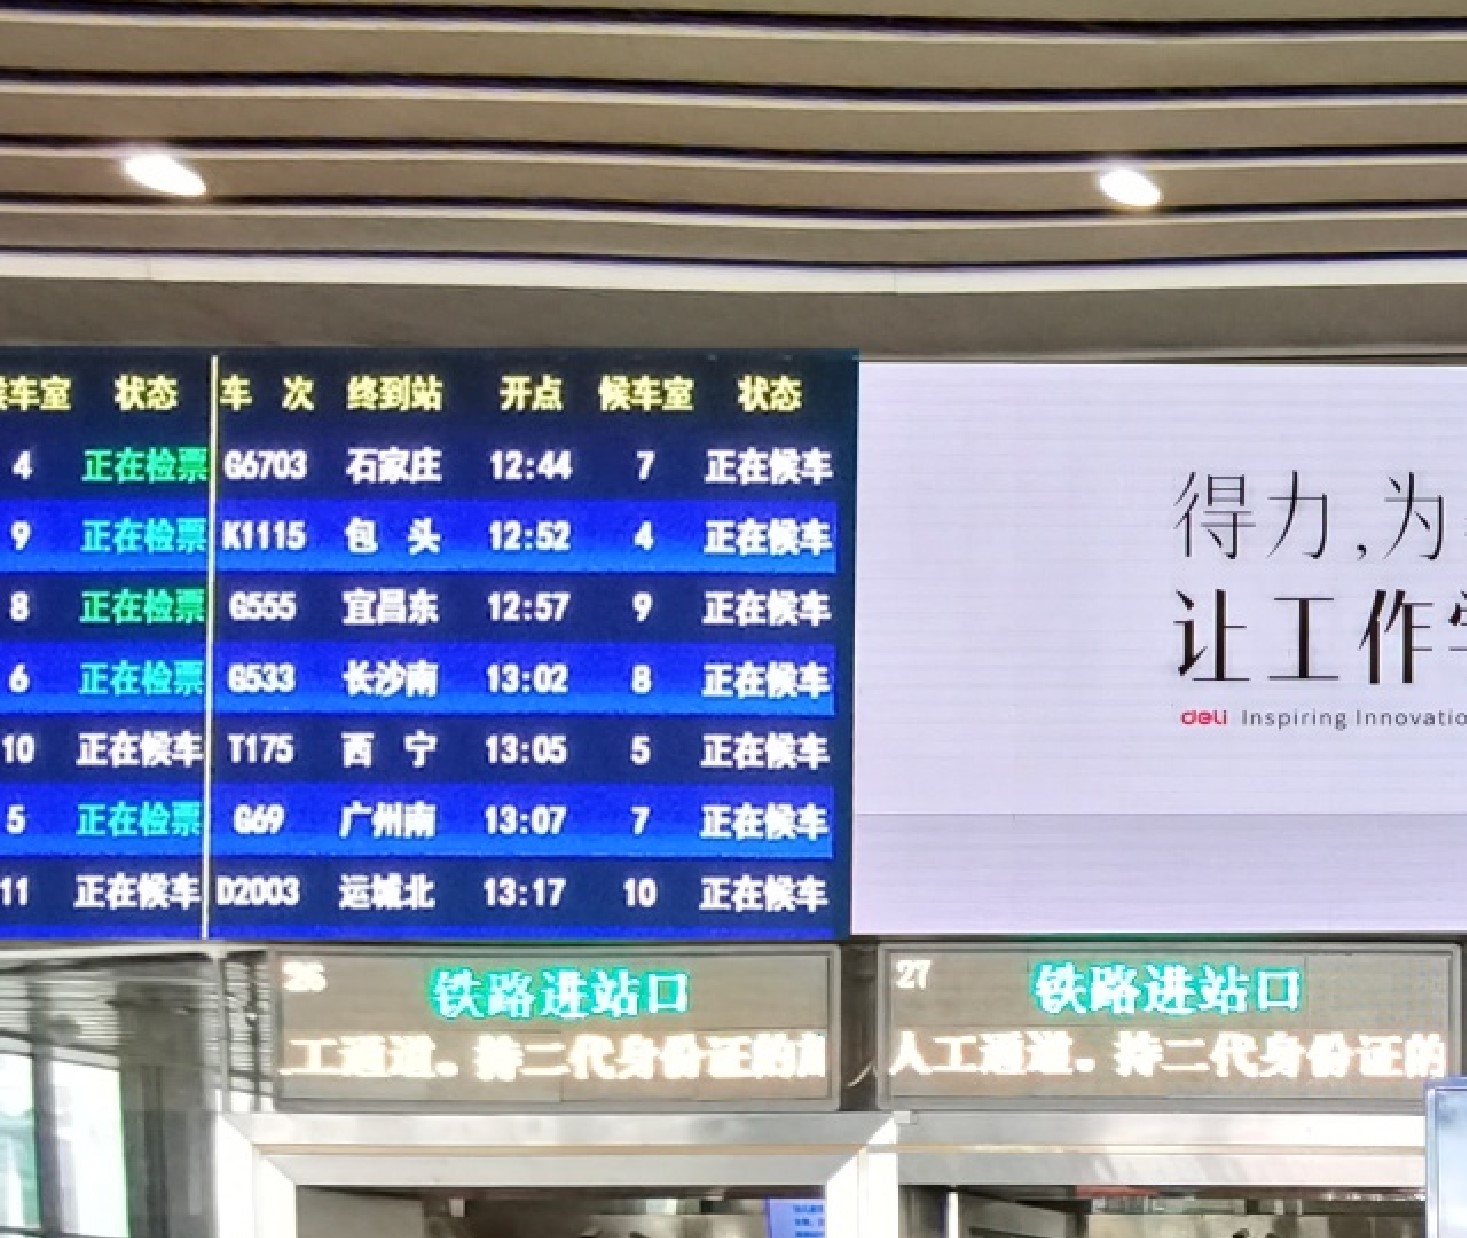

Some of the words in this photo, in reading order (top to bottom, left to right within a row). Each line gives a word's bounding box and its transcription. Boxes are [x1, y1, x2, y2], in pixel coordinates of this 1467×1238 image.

[0, 376, 72, 410] 车室
[116, 376, 177, 410] 状态
[348, 376, 443, 411] 终到站
[501, 376, 562, 411] 开点
[599, 376, 695, 411] 候车室
[739, 376, 802, 411] 状态
[15, 451, 33, 479] 4
[83, 447, 207, 482] 正在检票
[225, 449, 308, 480] G6703
[347, 447, 443, 484] 石家庄
[491, 449, 574, 480] 12:44
[638, 449, 654, 480] 7
[706, 447, 833, 484] 正在候车
[12, 522, 31, 550] 9
[82, 518, 206, 552] 正在检票
[223, 520, 306, 550] K1115
[490, 520, 572, 550] 12:52
[636, 520, 654, 550] 4
[705, 518, 833, 555] 正在候车
[12, 591, 31, 621] 8
[81, 589, 204, 623] 正在检票
[229, 591, 297, 620] G555
[344, 589, 439, 624] 宜昌东
[489, 591, 572, 620] 12:57
[633, 591, 652, 620] 9
[703, 589, 833, 624] 正在候车
[10, 665, 30, 692] 6
[80, 660, 203, 696] 正在检票
[228, 664, 297, 693] G533
[344, 660, 439, 697] 长沙南
[488, 664, 569, 693] 13:02
[632, 664, 652, 693] 8
[702, 660, 831, 697] 正在候车
[1241, 708, 1347, 730] Inspiring
[1, 736, 35, 763] 10
[78, 731, 203, 768] 正在候车
[229, 733, 294, 763] T175
[487, 733, 567, 763] 13:05
[632, 733, 650, 763] 5
[701, 731, 831, 768] 正在候车
[7, 806, 26, 834] 5
[78, 802, 201, 836] 正在检票
[234, 804, 285, 834] G69
[340, 802, 436, 839] 广州南
[486, 804, 567, 834] 13:07
[633, 804, 650, 834] 7
[700, 802, 829, 839] 正在候车
[1, 878, 28, 905] 11
[74, 873, 200, 910] 正在候车
[217, 876, 301, 906] D2003
[339, 873, 436, 911] 运城北
[485, 876, 567, 906] 13:17
[624, 876, 656, 906] 10
[700, 873, 828, 911] 正在候车
[897, 959, 932, 990] 27
[1033, 963, 1301, 1014] 铁路进站口
[433, 968, 689, 1019] 铁路进站口
